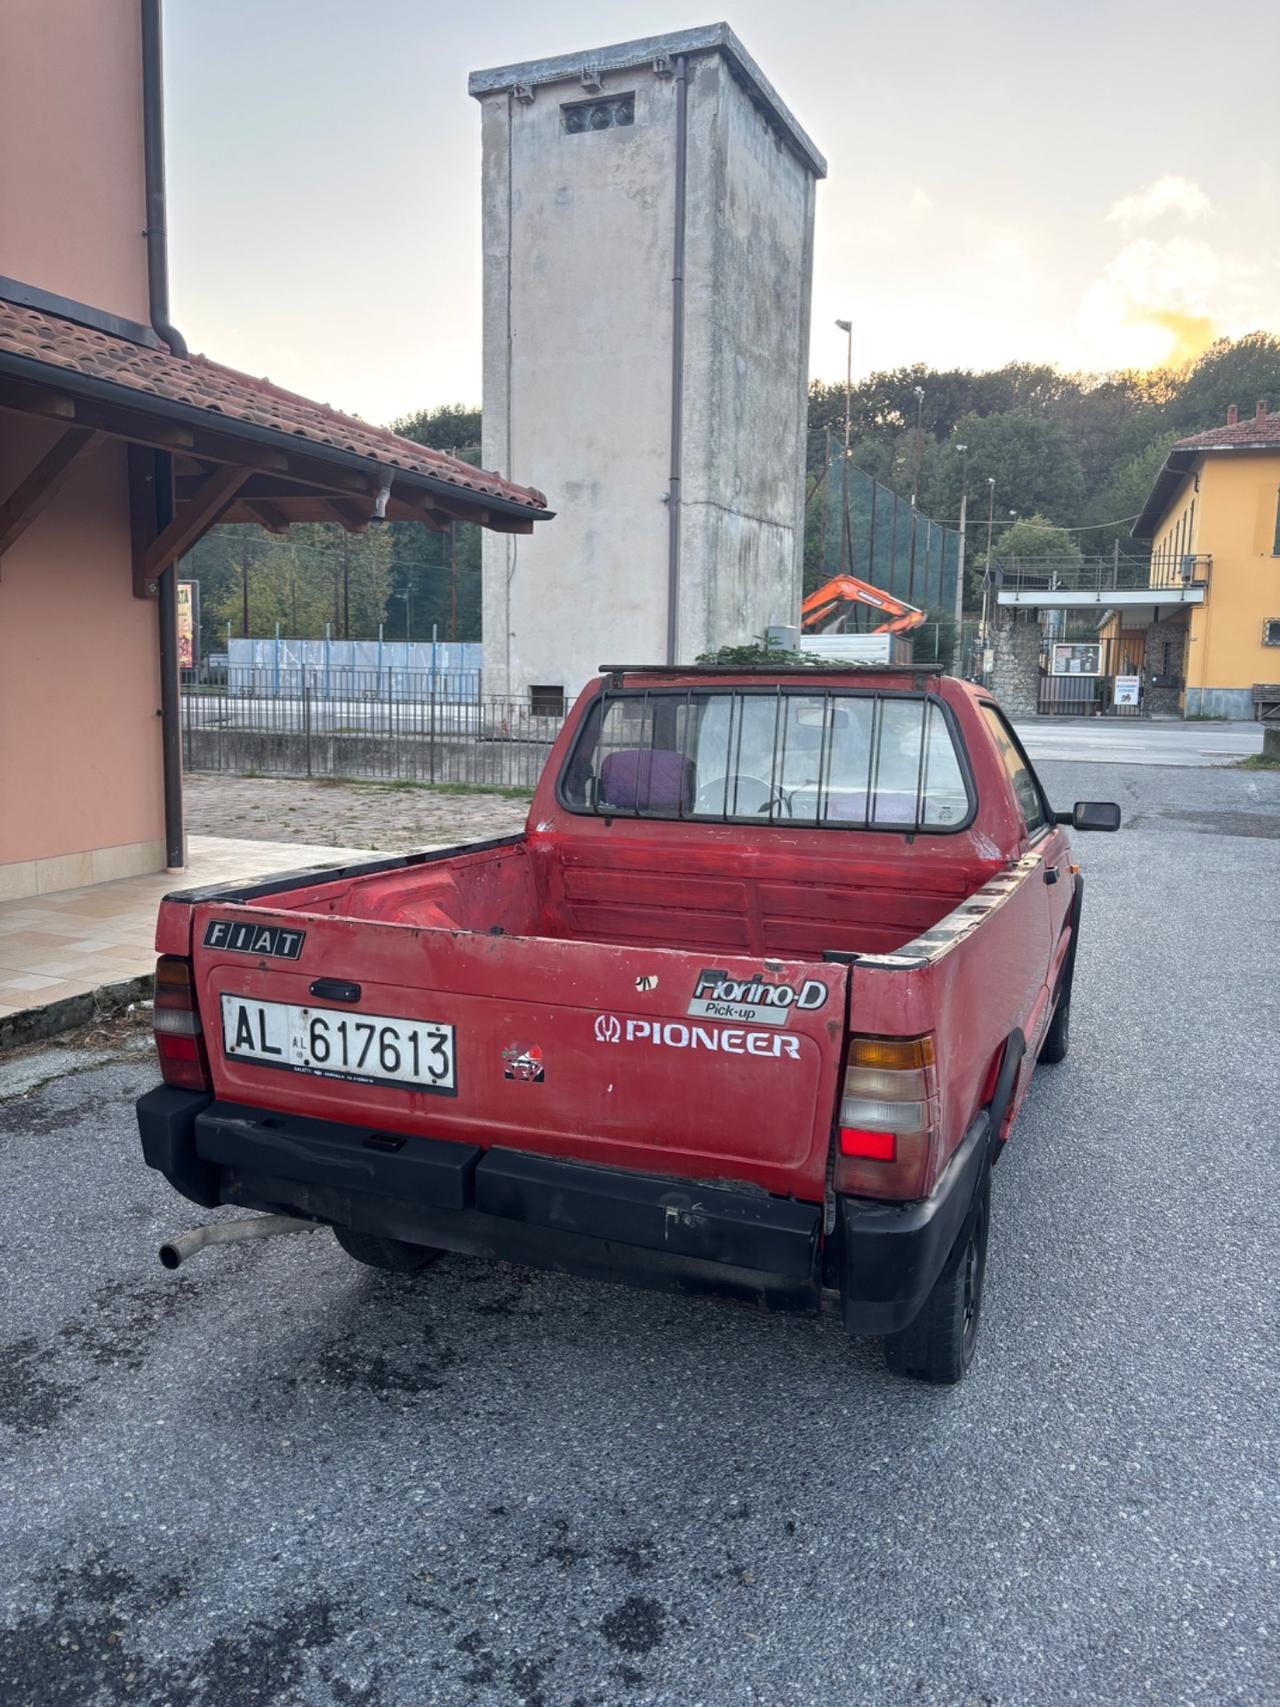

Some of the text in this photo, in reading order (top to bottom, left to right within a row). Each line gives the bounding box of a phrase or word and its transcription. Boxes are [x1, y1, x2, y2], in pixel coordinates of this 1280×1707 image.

[209, 924, 298, 955] FIAT
[704, 1002, 756, 1021] Pick-up
[235, 1005, 450, 1080] AL 617613
[292, 1036, 307, 1050] AL
[626, 1019, 801, 1060] PIONEER
